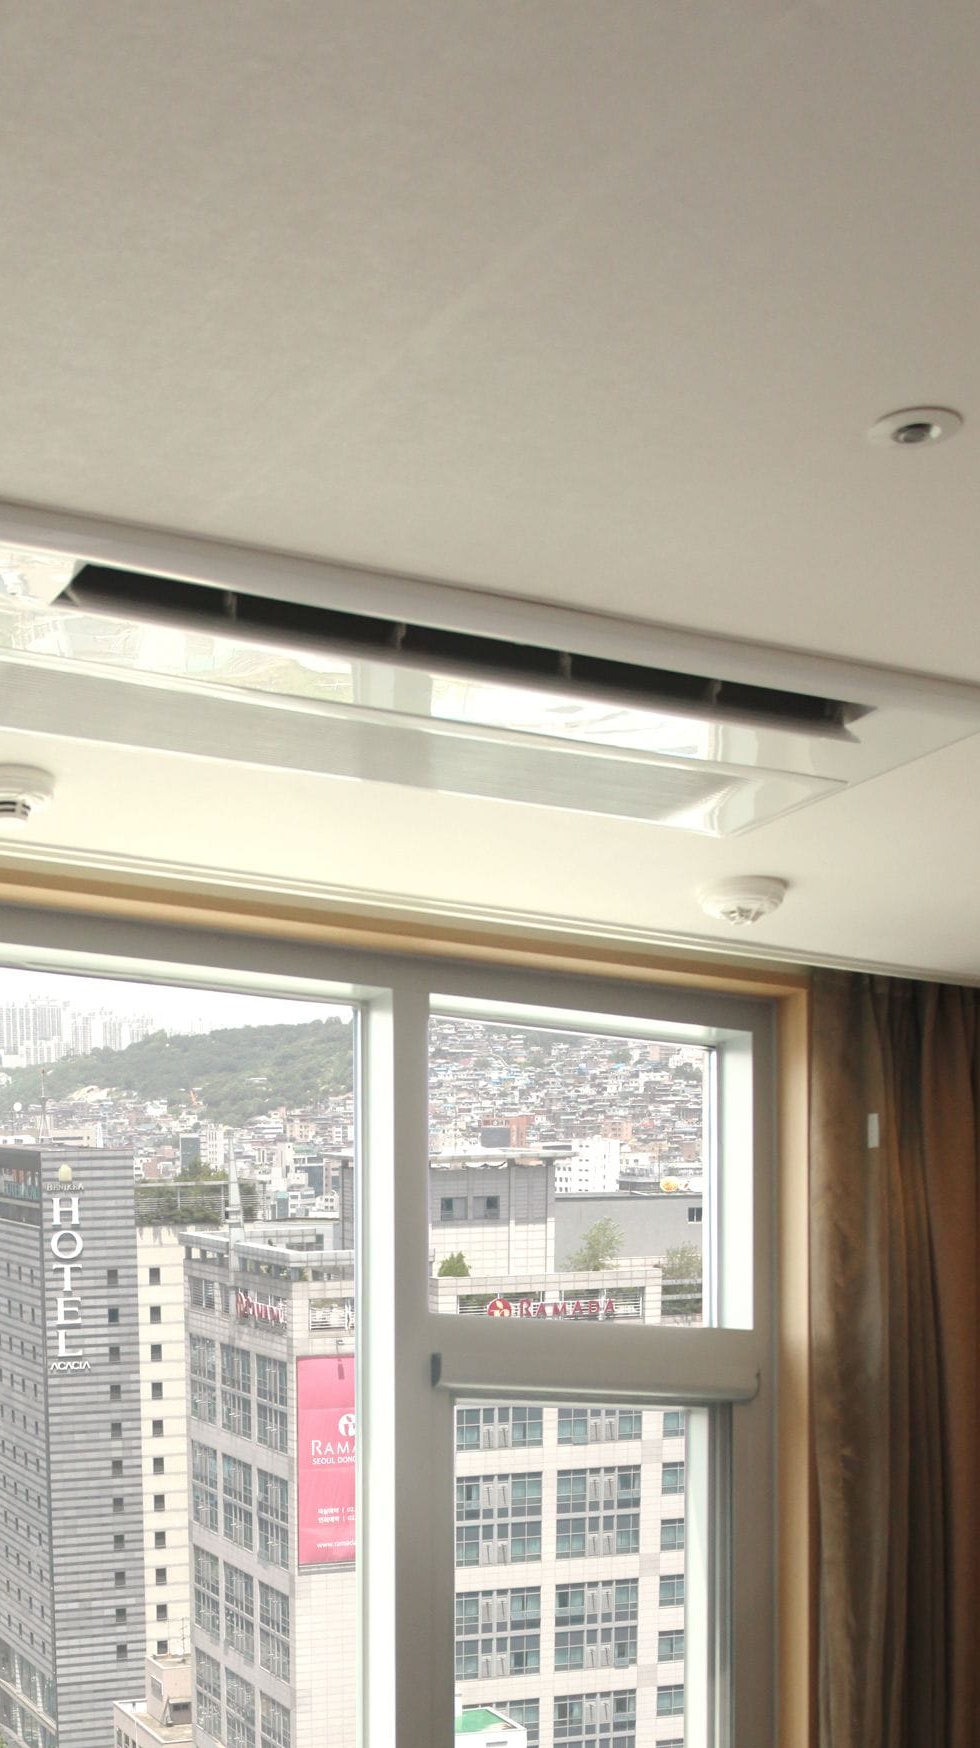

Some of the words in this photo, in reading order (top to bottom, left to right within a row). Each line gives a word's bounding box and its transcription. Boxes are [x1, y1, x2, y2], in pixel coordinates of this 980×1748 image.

[50, 1196, 84, 1357] HOTEL
[519, 1298, 616, 1318] RAMADA
[50, 1360, 91, 1371] ACACIA
[312, 1457, 336, 1465] SEOUL
